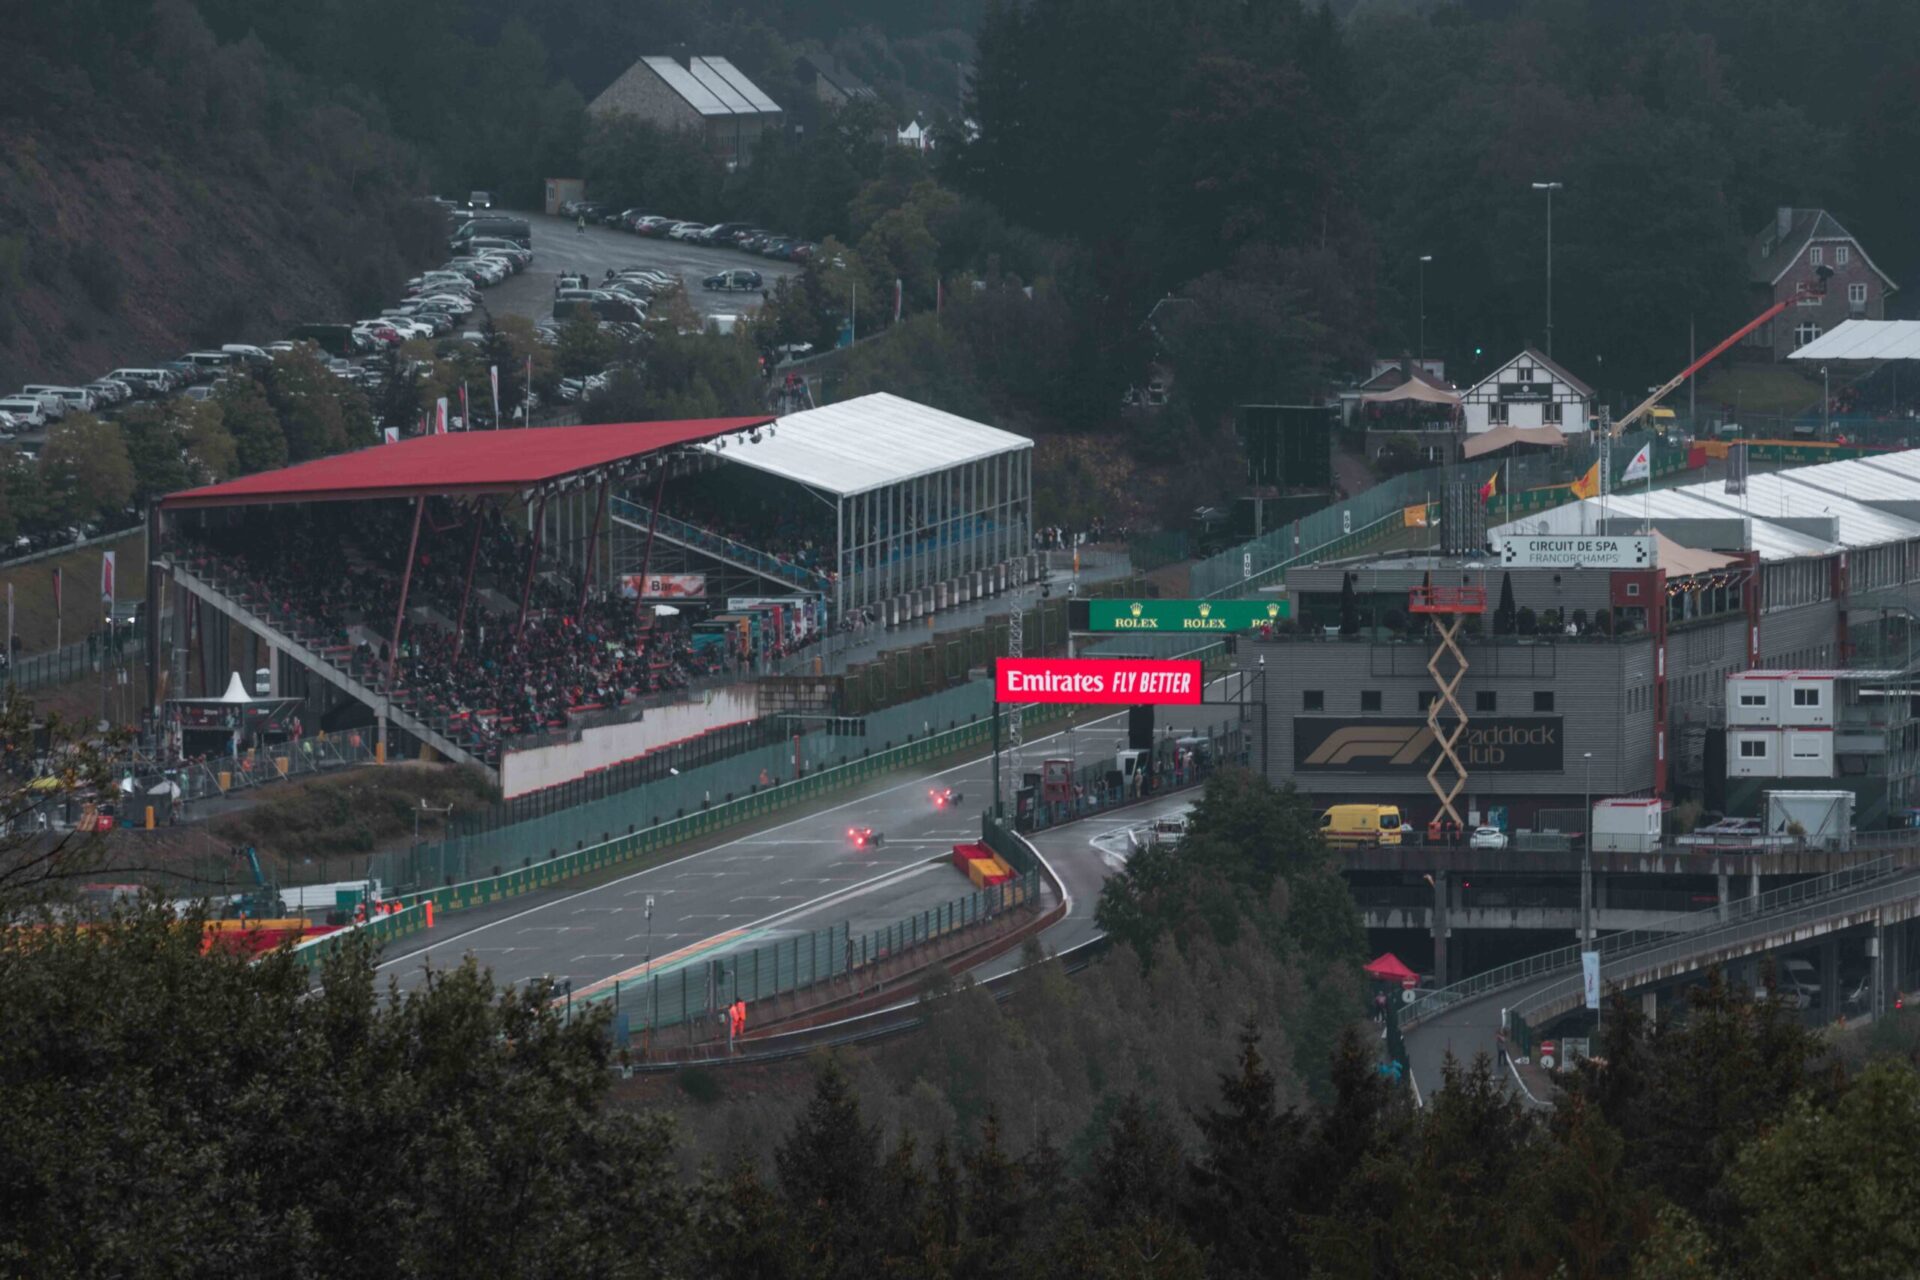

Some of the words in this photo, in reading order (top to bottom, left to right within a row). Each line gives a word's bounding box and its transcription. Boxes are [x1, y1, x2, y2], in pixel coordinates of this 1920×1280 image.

[1529, 541, 1573, 552] CIRCUIT
[1577, 541, 1592, 552] DE
[1595, 541, 1618, 552] SPA
[1529, 553, 1619, 564] FRANCORCHAMPS
[651, 580, 673, 592] Bar
[1115, 618, 1158, 628] ROLEX
[1183, 618, 1226, 629] ROLEX
[1006, 670, 1104, 693] Emirates
[1112, 671, 1137, 693] FLY
[1139, 672, 1191, 694] BETTER
